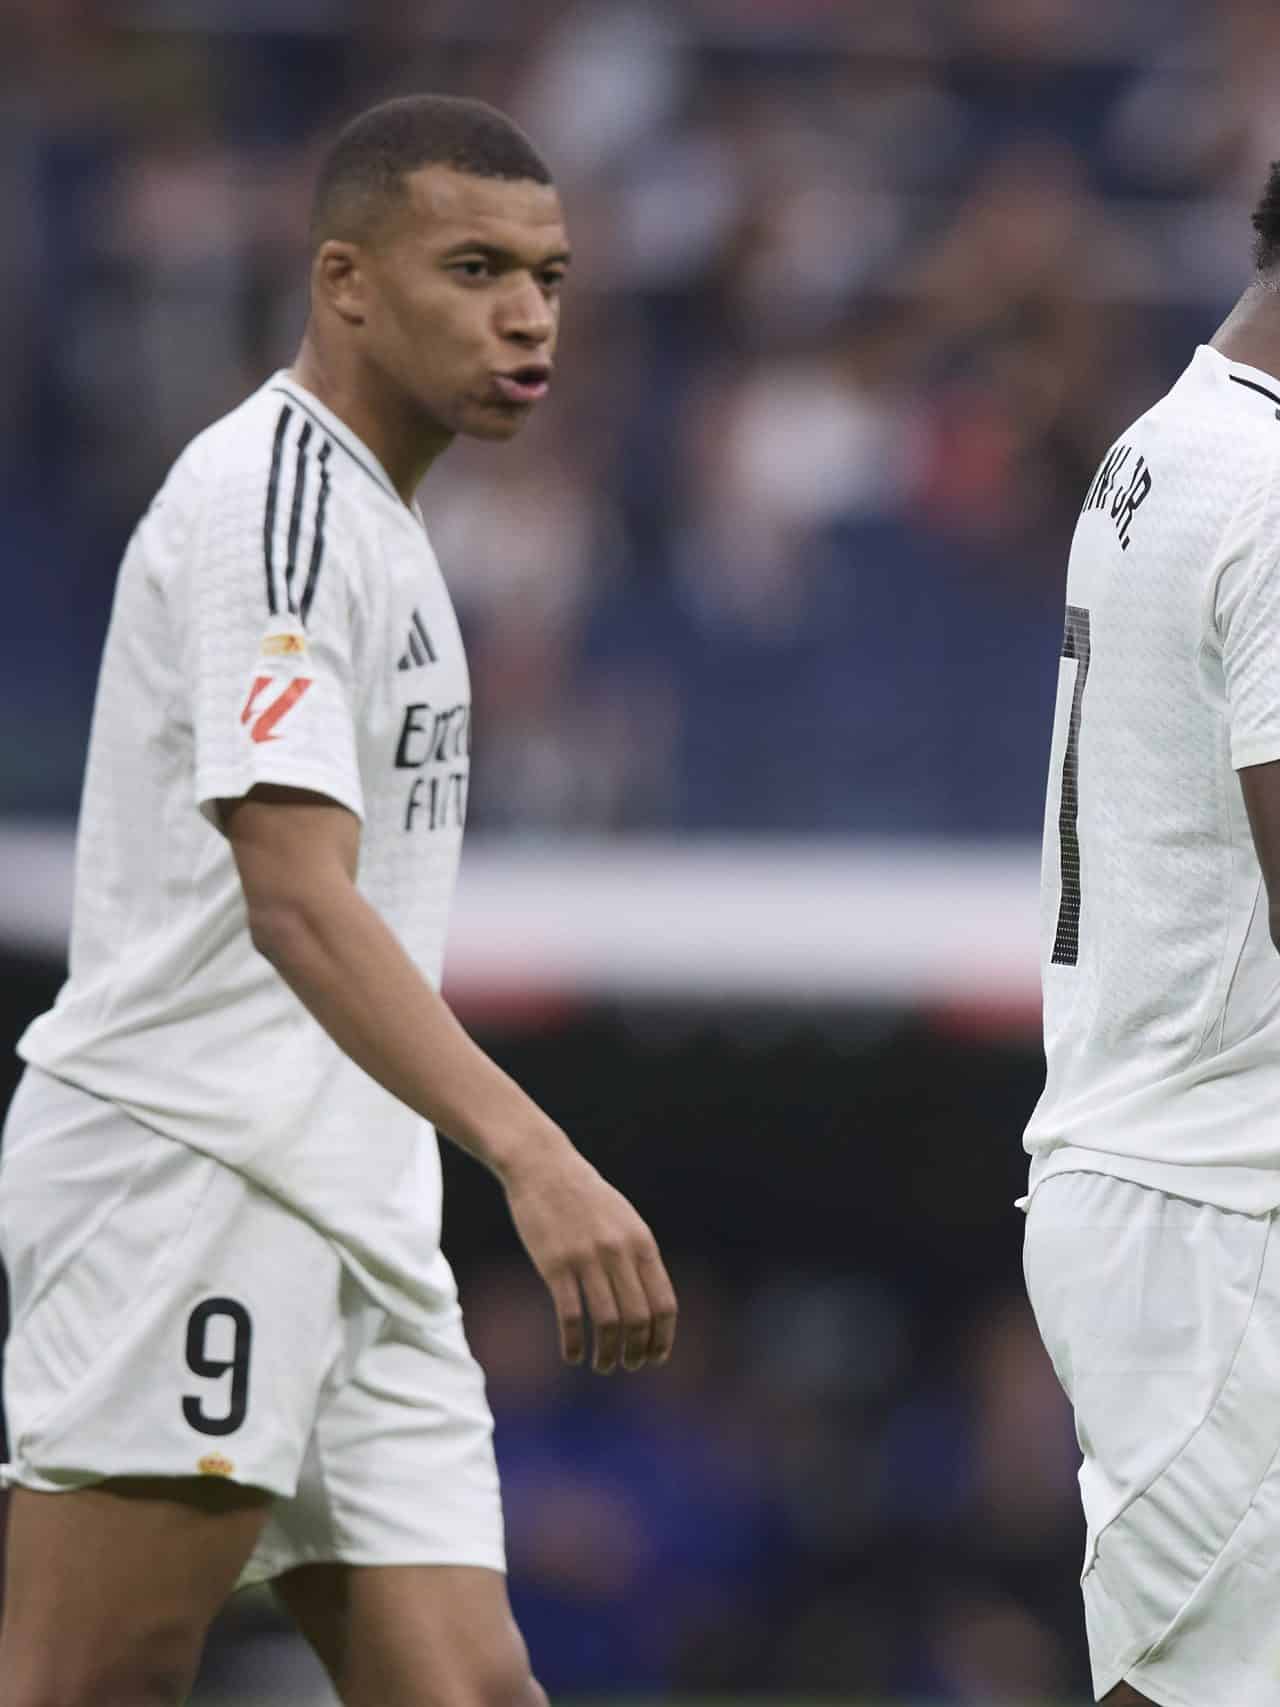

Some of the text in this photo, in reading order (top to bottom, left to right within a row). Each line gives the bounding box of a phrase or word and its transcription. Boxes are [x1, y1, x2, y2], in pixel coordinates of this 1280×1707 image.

[1110, 455, 1152, 552] JR.
[1050, 604, 1091, 967] 7
[181, 1297, 253, 1436] 9
